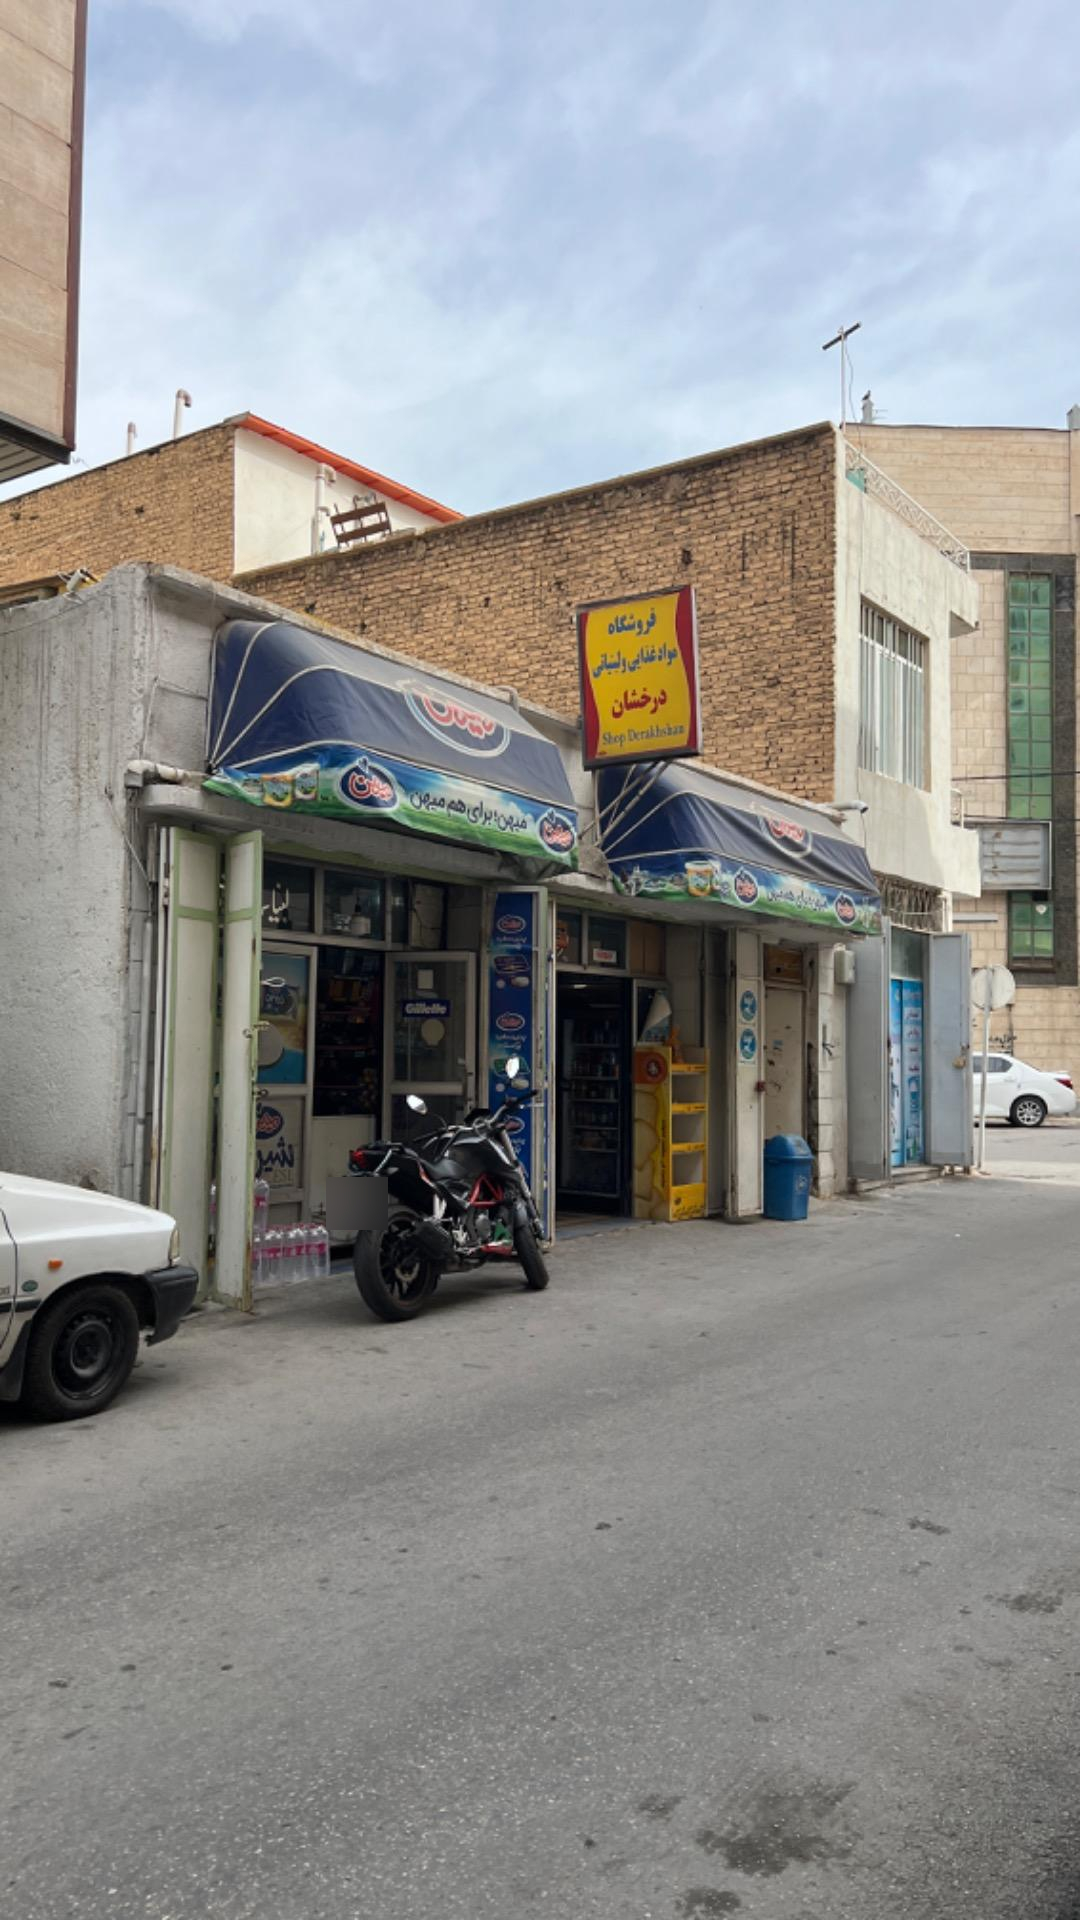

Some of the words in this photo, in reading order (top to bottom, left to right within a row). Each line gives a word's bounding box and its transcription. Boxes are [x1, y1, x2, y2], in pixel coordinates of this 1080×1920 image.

[608, 608, 656, 636] فروشگاه
[657, 642, 678, 666] مواد
[612, 688, 667, 719] درخشان
[602, 731, 626, 747] Shop
[627, 724, 686, 743] Derakhshan
[349, 771, 393, 801] میهن
[410, 791, 445, 811] میهن
[447, 798, 466, 816] هم
[467, 801, 493, 826] برای
